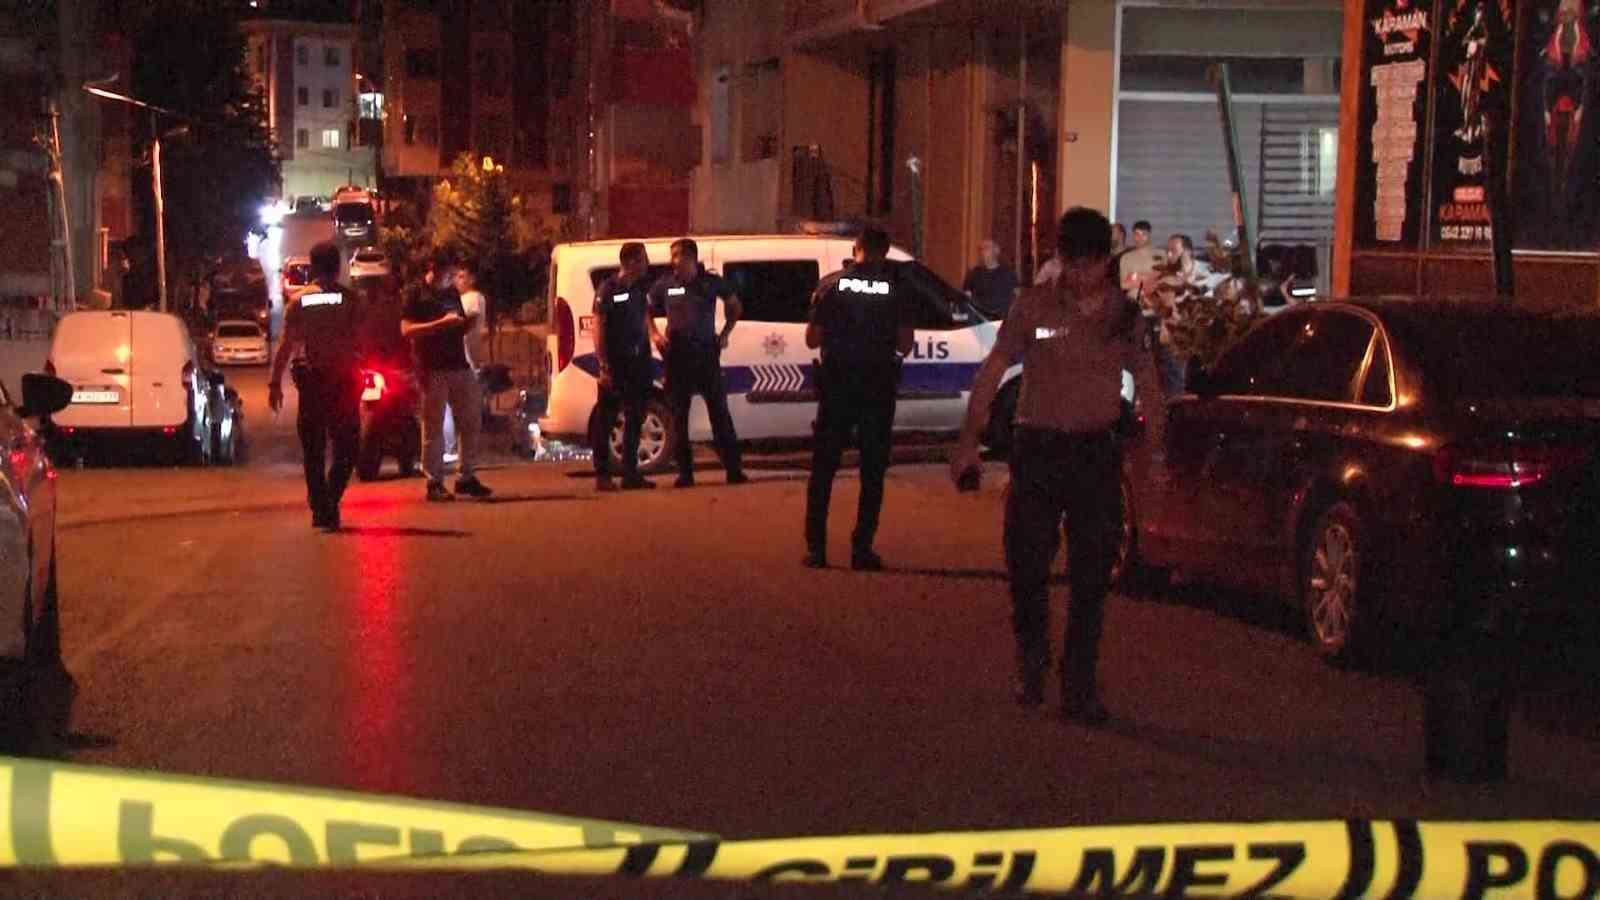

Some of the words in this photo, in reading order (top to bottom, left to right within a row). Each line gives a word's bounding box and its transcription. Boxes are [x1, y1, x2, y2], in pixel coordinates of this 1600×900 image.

[1440, 203, 1490, 220] KARAMA
[911, 336, 949, 360] LİS
[750, 841, 1306, 900] İLMEZ
